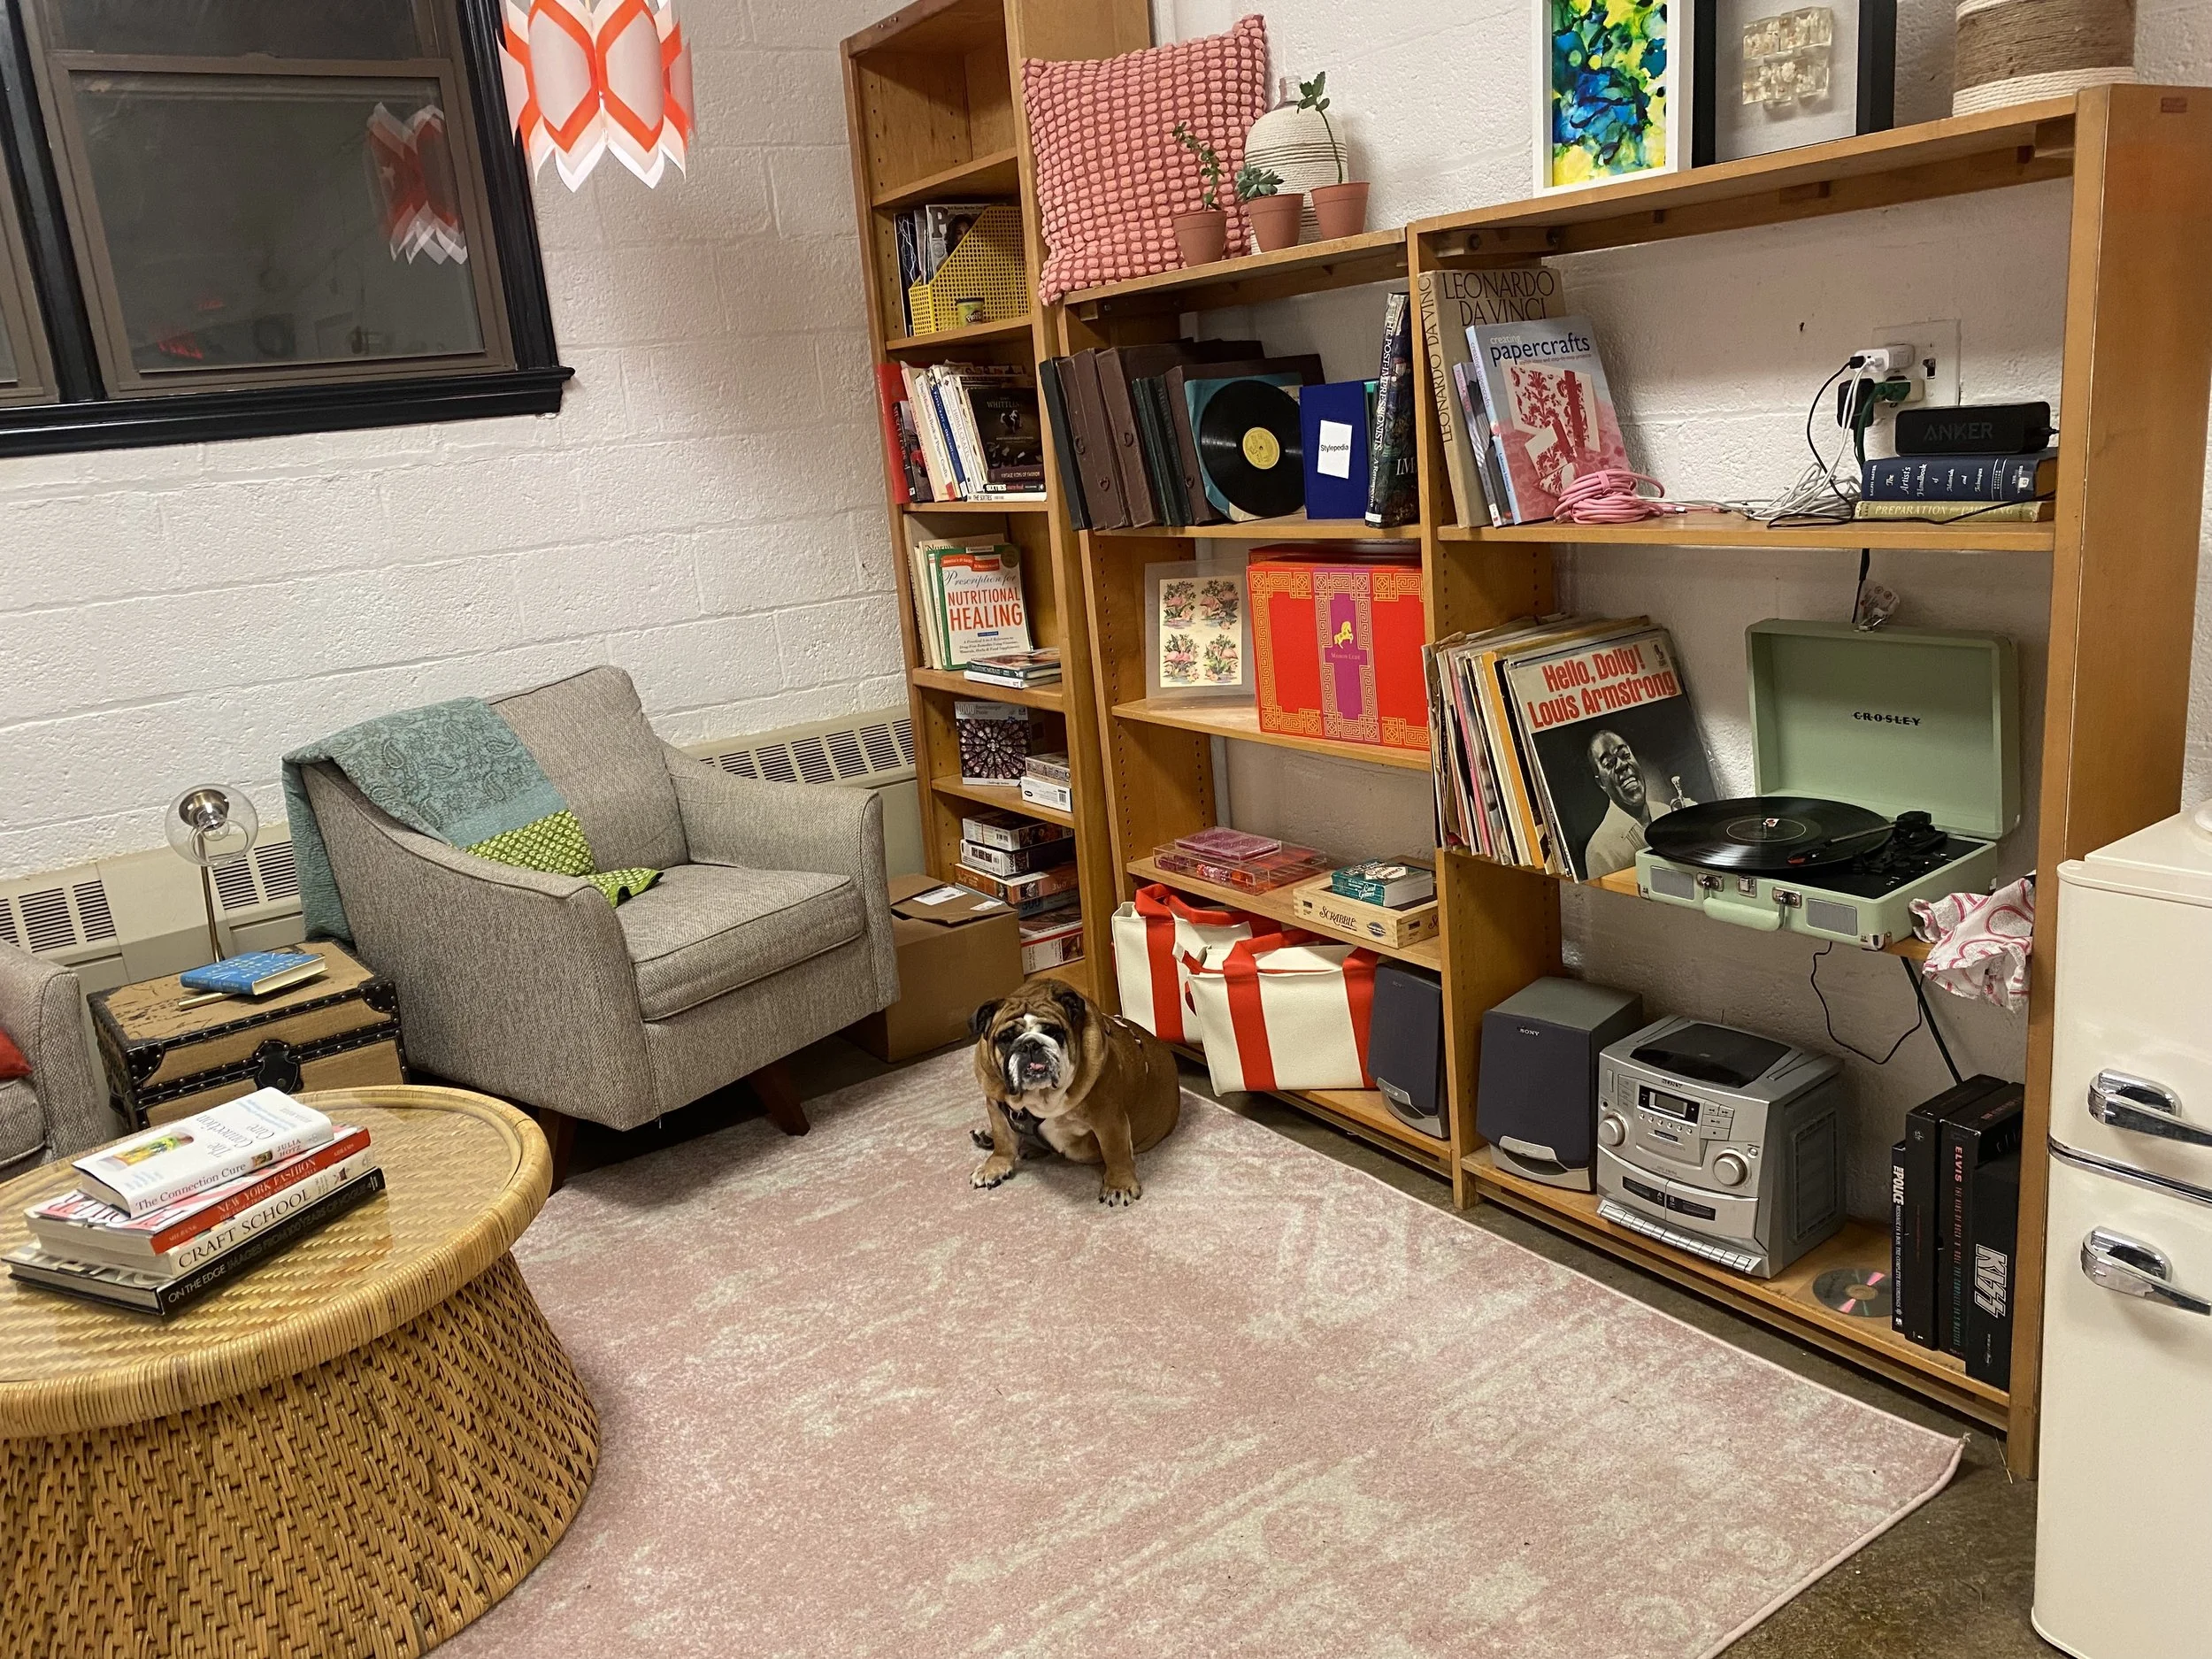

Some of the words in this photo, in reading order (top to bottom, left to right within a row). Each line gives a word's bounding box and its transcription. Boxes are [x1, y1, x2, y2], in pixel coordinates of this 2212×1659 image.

[1417, 274, 1435, 320] VINC
[1443, 270, 1555, 299] LEONARDO
[1385, 315, 1394, 334] THE
[1459, 299, 1486, 326] DA
[1488, 297, 1547, 324] VINCI
[1425, 324, 1439, 347] DA
[1490, 335, 1521, 344] creating
[1490, 332, 1590, 367] papercrafts
[1372, 339, 1392, 450] POST-IMPRESSIONISTS
[1429, 352, 1452, 442] LEONARDO
[1924, 422, 1993, 442] ANKER
[1320, 443, 1349, 454] Stylepedia
[1886, 474, 1894, 487] The
[1900, 466, 1911, 495] Artist's
[1916, 464, 1927, 496] Handbook
[1875, 504, 1947, 515] PREPARATION
[943, 571, 1002, 587] Prescription
[1002, 574, 1016, 587] for
[948, 587, 1021, 606] NUTRITIONAL
[949, 603, 1023, 631] HEALING
[1542, 658, 1596, 692] Hello,
[1592, 644, 1645, 680] Dolly!
[1527, 694, 1581, 729] Louis
[1581, 669, 1677, 716] Armstrong
[1853, 711, 1921, 726] CROSLEY
[1319, 906, 1357, 928] SCRABBLE
[1519, 1027, 1540, 1036] SONY
[275, 1138, 301, 1152] JULIA
[134, 1194, 157, 1212] The
[158, 1171, 219, 1202] Connection
[220, 1161, 246, 1178] Cure
[216, 1195, 240, 1214] NEW
[243, 1179, 272, 1201] YORK
[272, 1156, 316, 1186] FASHION
[1893, 1170, 1903, 1207] POLICE
[177, 1226, 237, 1270] CRAFT
[240, 1187, 311, 1235] SCHOOL
[166, 1286, 185, 1304] ON
[183, 1277, 202, 1294] THE
[201, 1263, 226, 1284] EDGE
[1974, 1243, 2008, 1319] KISS
